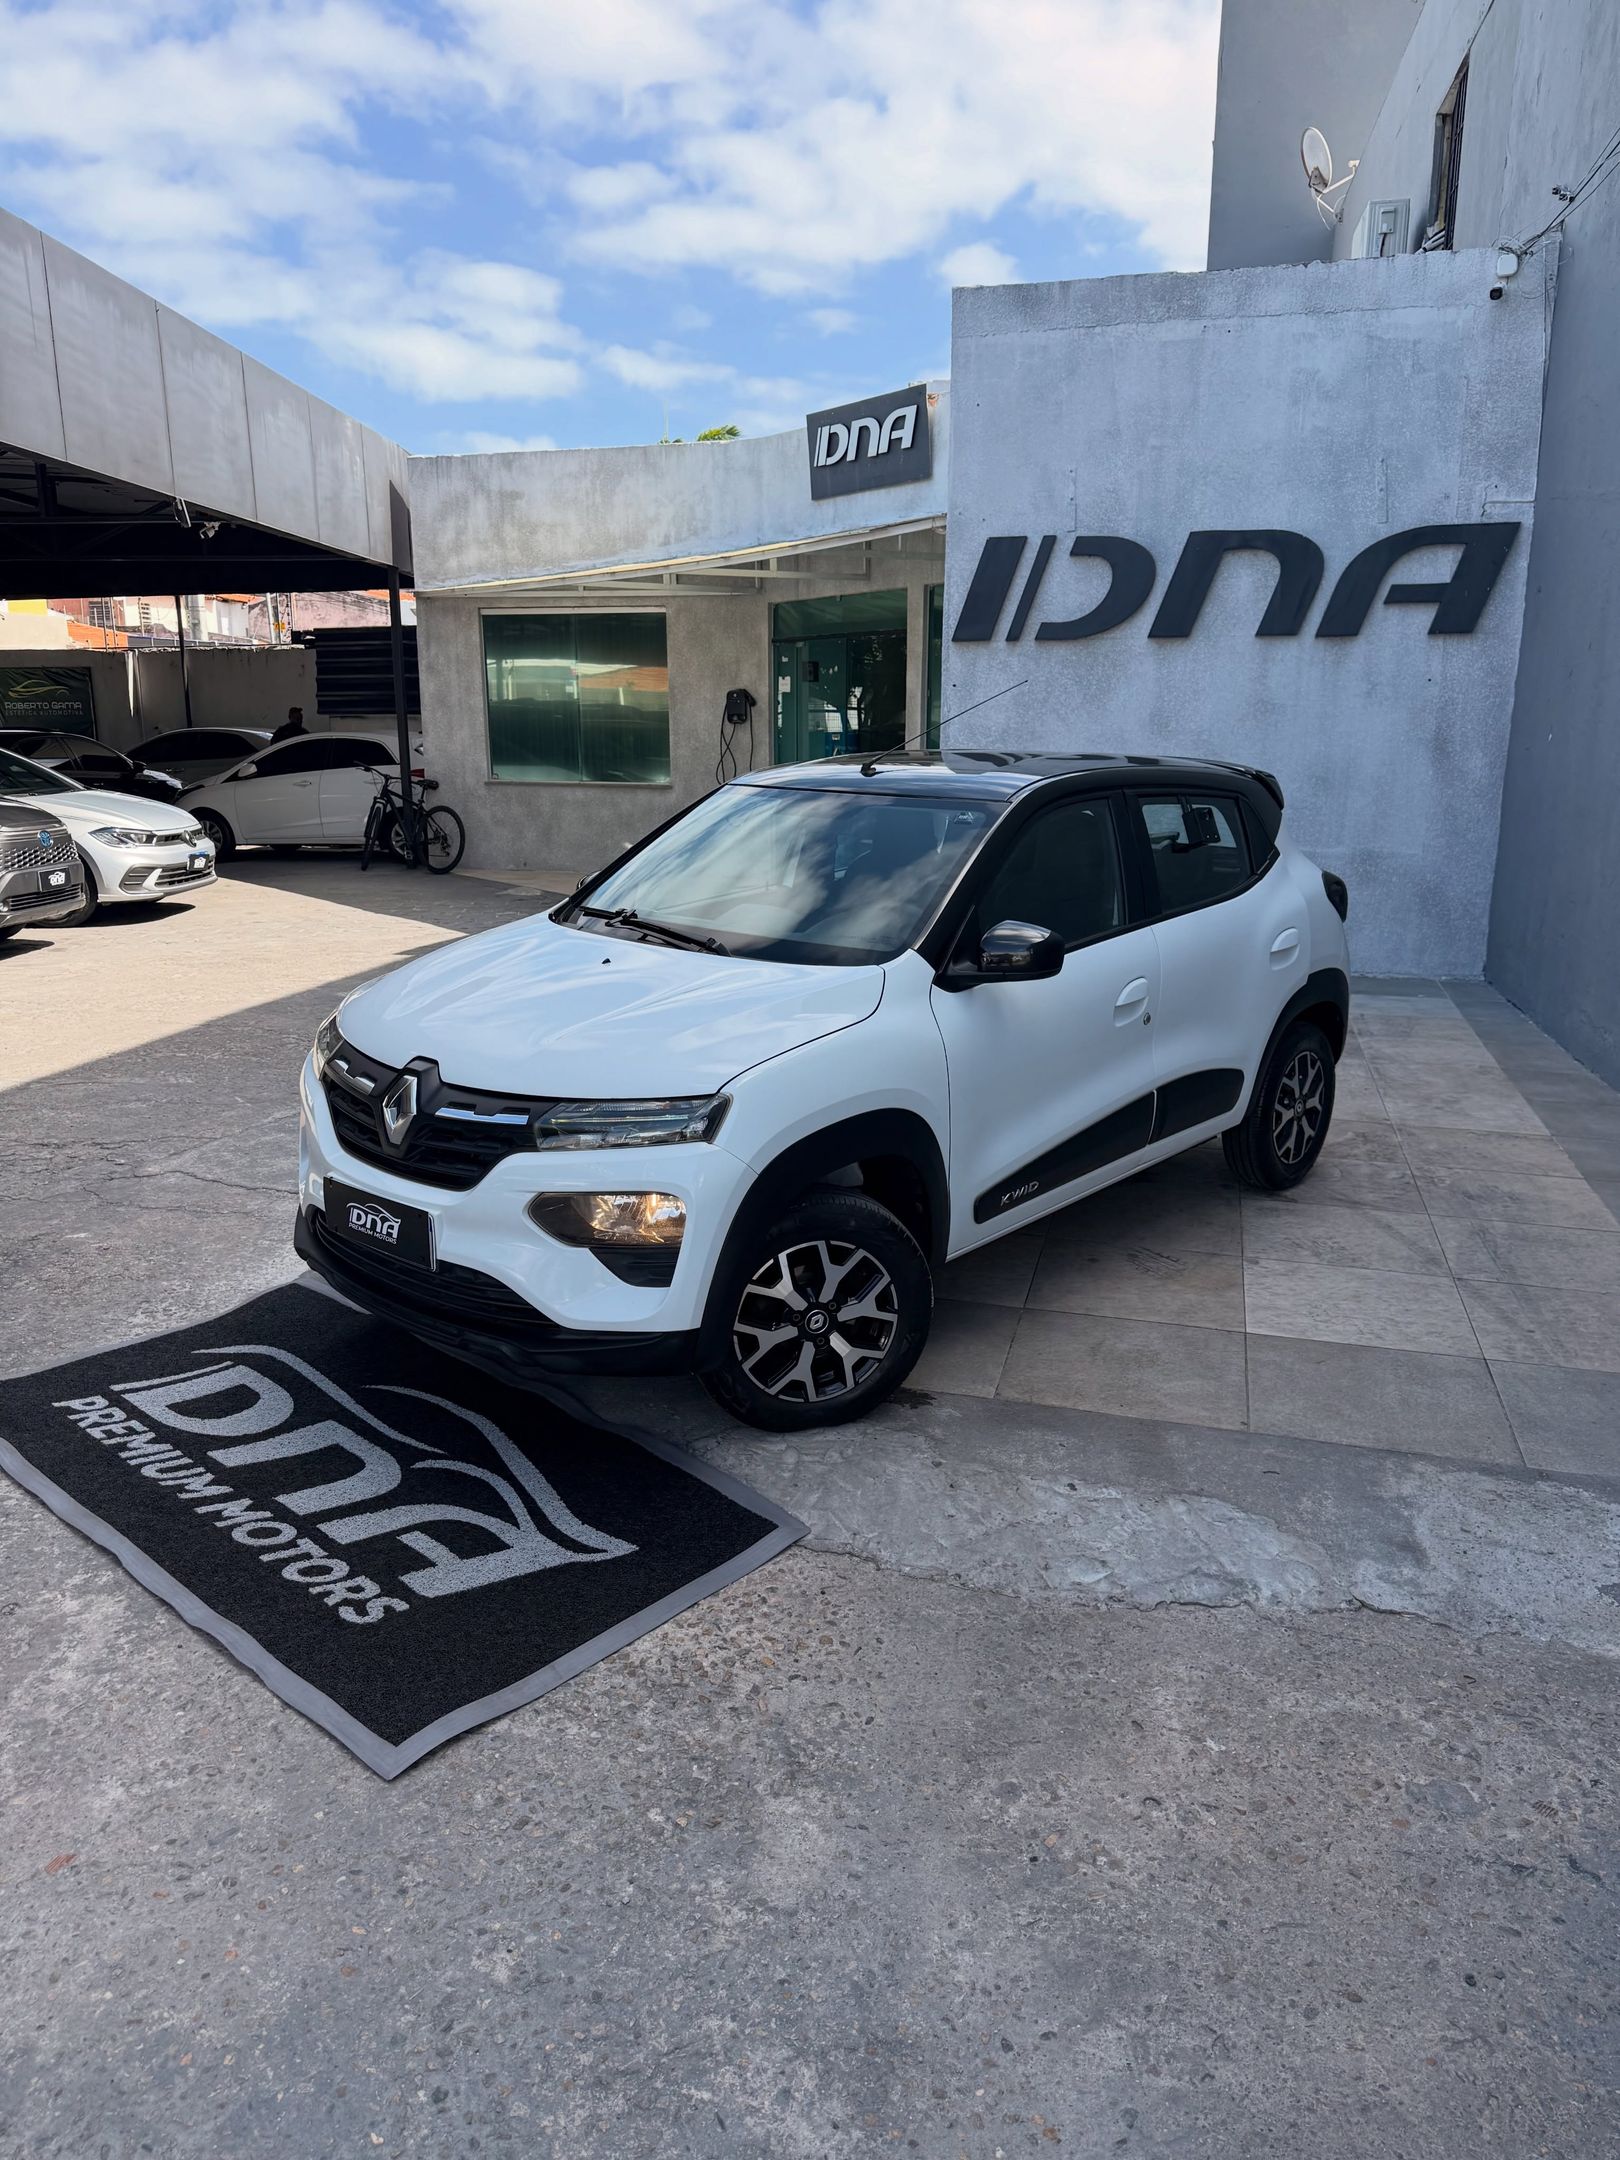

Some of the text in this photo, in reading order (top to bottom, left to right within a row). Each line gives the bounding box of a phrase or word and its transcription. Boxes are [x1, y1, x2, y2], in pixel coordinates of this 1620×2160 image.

[4, 701, 82, 710] ROBERTO GAMA
[1000, 1180, 1040, 1206] KWID
[348, 1222, 397, 1245] PREMIUM MOTORS
[52, 1395, 410, 1626] PREMIUM MOTORS
